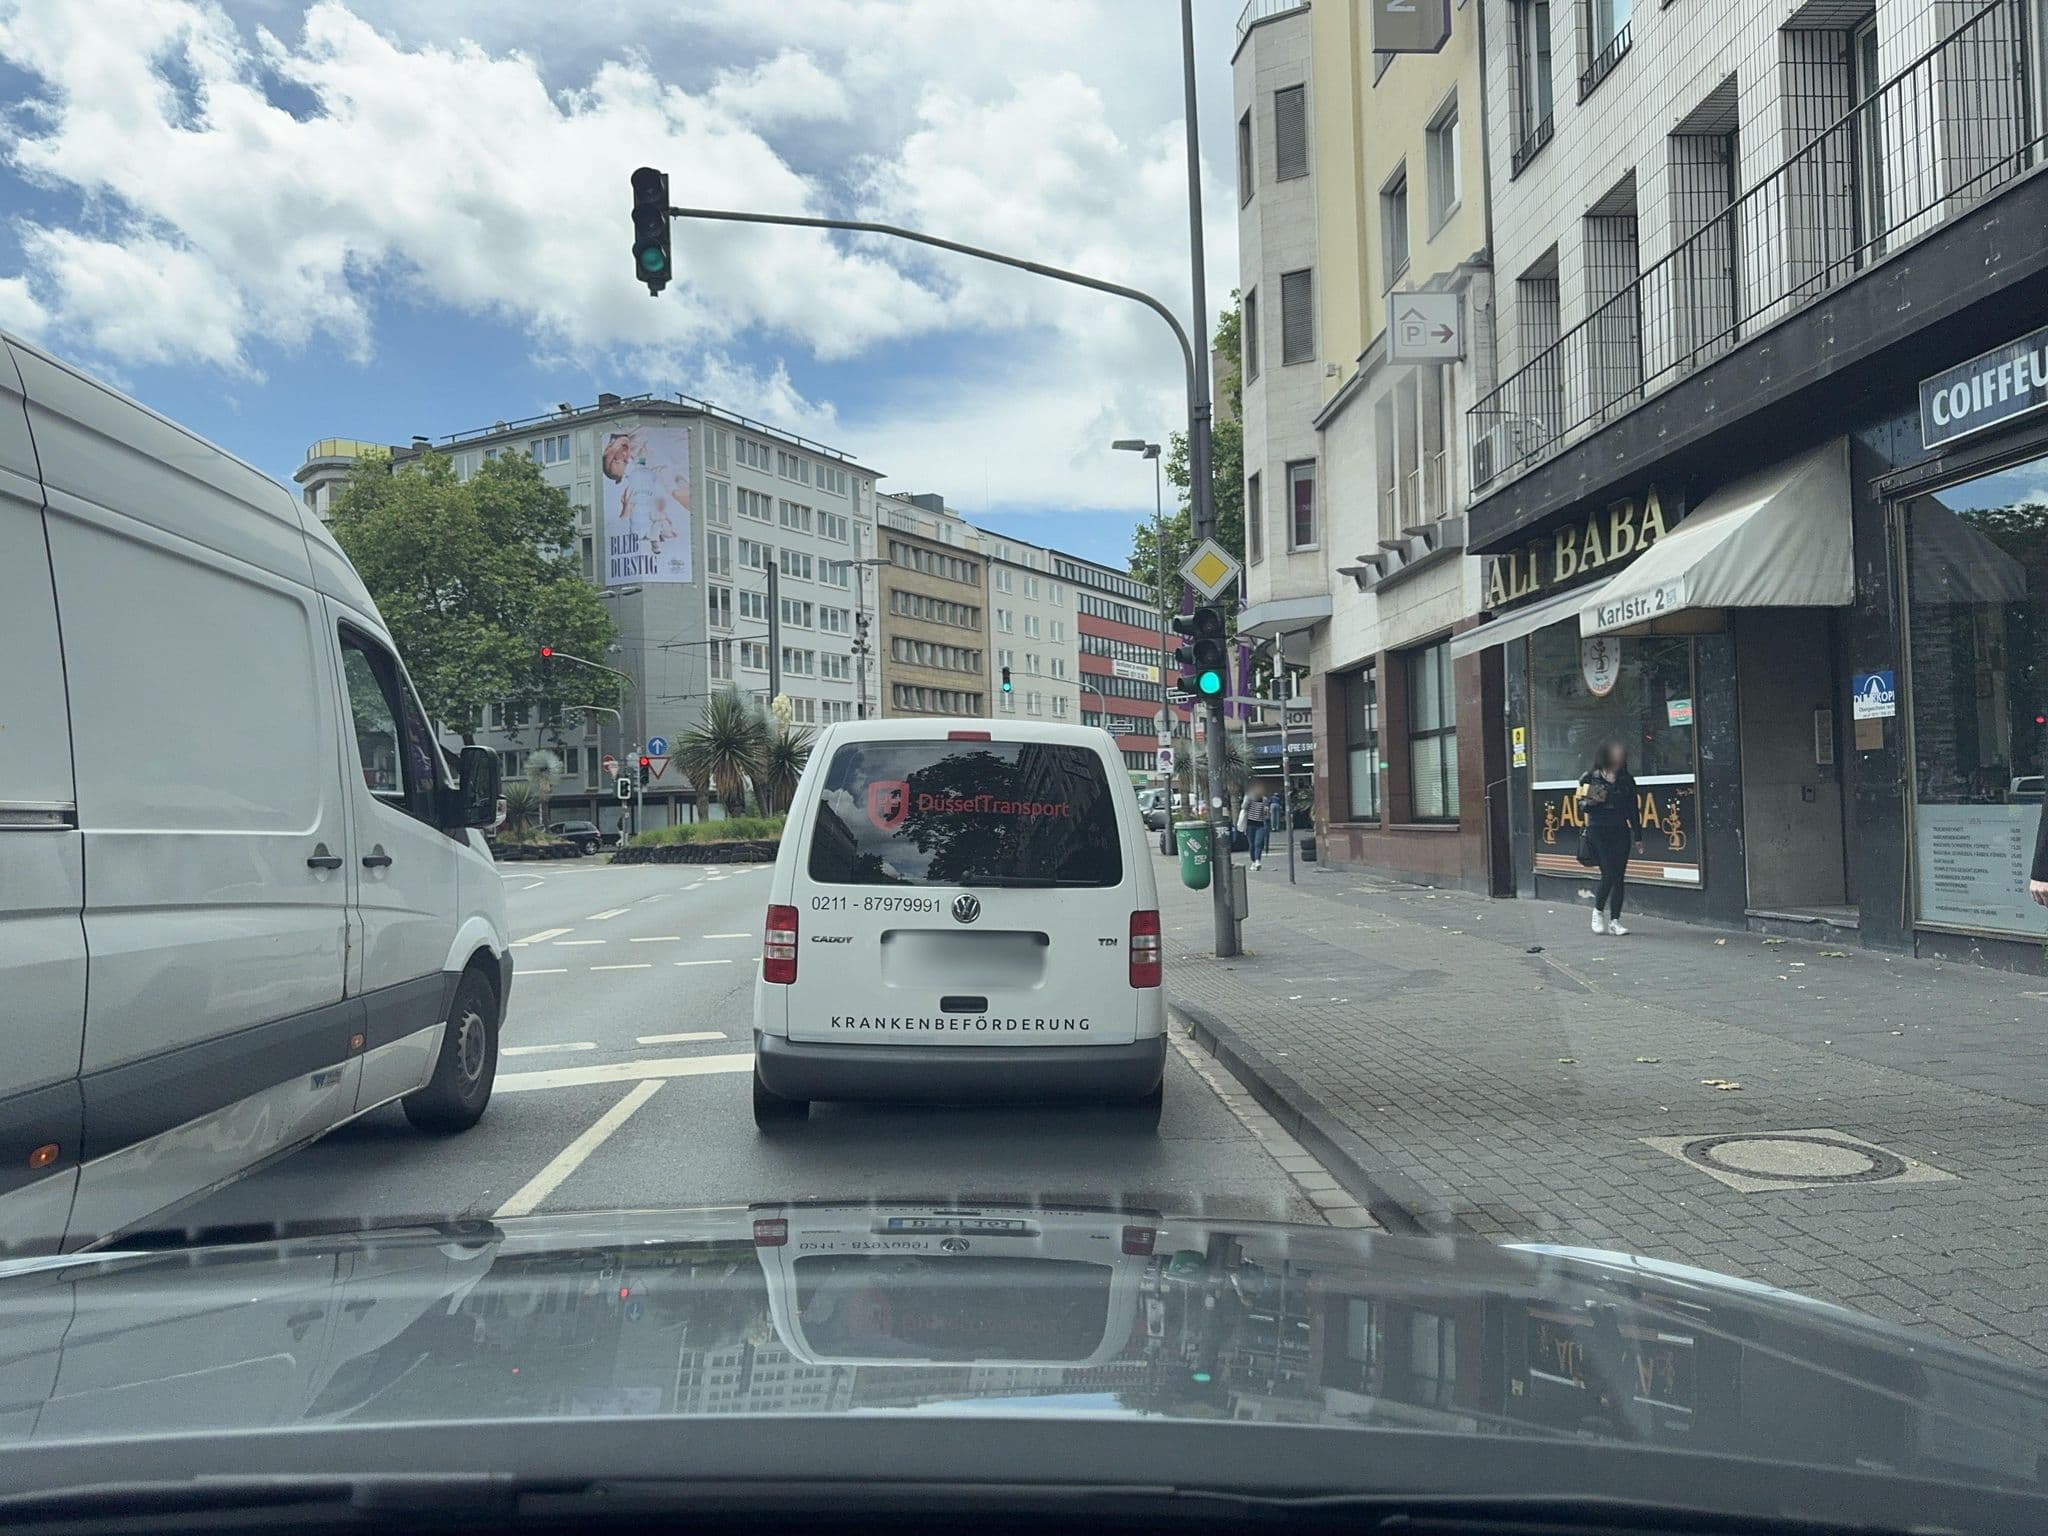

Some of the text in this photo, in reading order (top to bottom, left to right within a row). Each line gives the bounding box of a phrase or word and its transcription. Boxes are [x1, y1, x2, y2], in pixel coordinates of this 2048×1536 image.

[1933, 346, 2048, 426] COIFFEU
[611, 534, 639, 555] BLEIB
[1486, 483, 1667, 609] ALI BABA
[611, 555, 658, 578] DURSTIG
[1597, 597, 1651, 628] Karlstr.
[1655, 588, 1664, 611] 2
[1286, 712, 1312, 724] HOT
[918, 792, 1070, 818] DüsselTransport
[811, 896, 847, 911] 0211
[863, 896, 941, 913] 87979991
[1098, 938, 1118, 947] TDI
[831, 1015, 1091, 1031] KRANKENBEFÖRDERUNG
